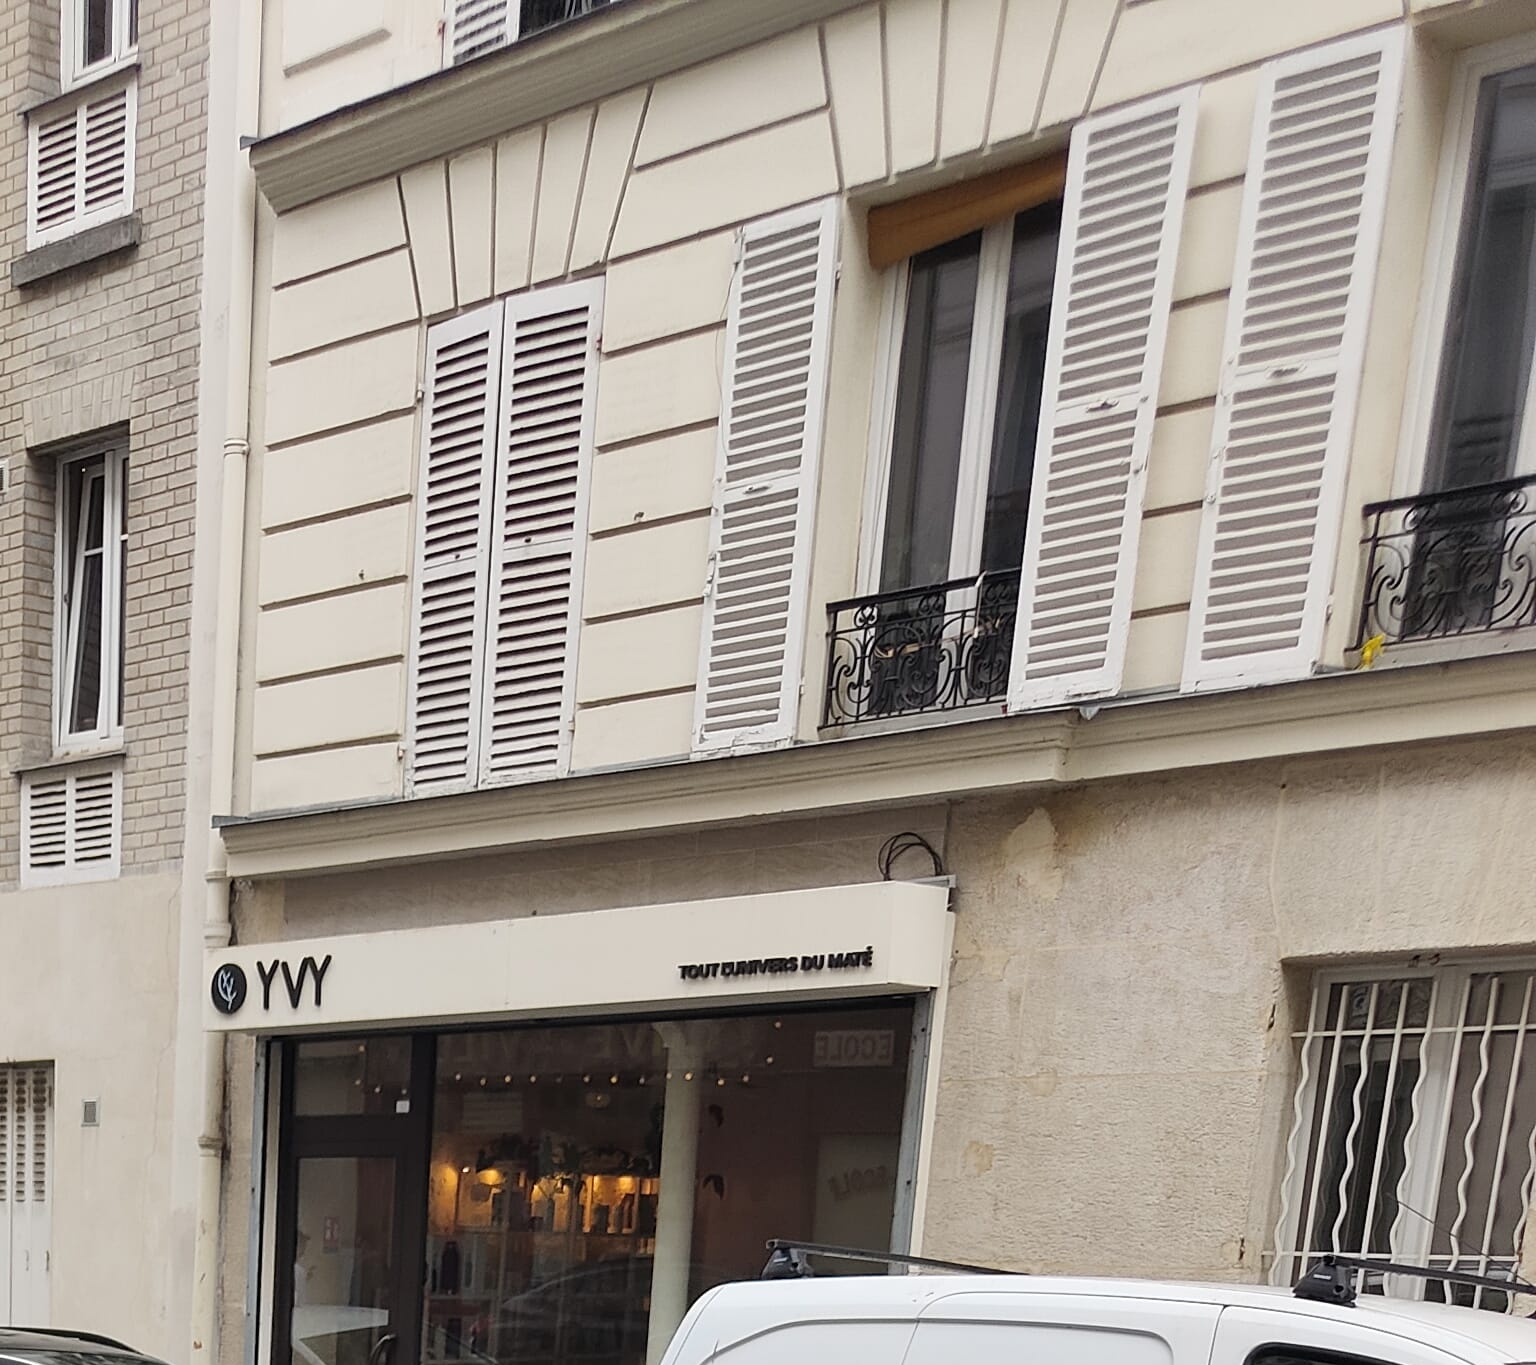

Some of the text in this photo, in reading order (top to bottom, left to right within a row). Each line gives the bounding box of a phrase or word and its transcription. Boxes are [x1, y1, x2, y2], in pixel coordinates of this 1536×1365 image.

[256, 954, 332, 1010] YVY
[678, 962, 720, 980] TOUT
[800, 954, 825, 971] DU
[827, 945, 874, 969] MATÉ
